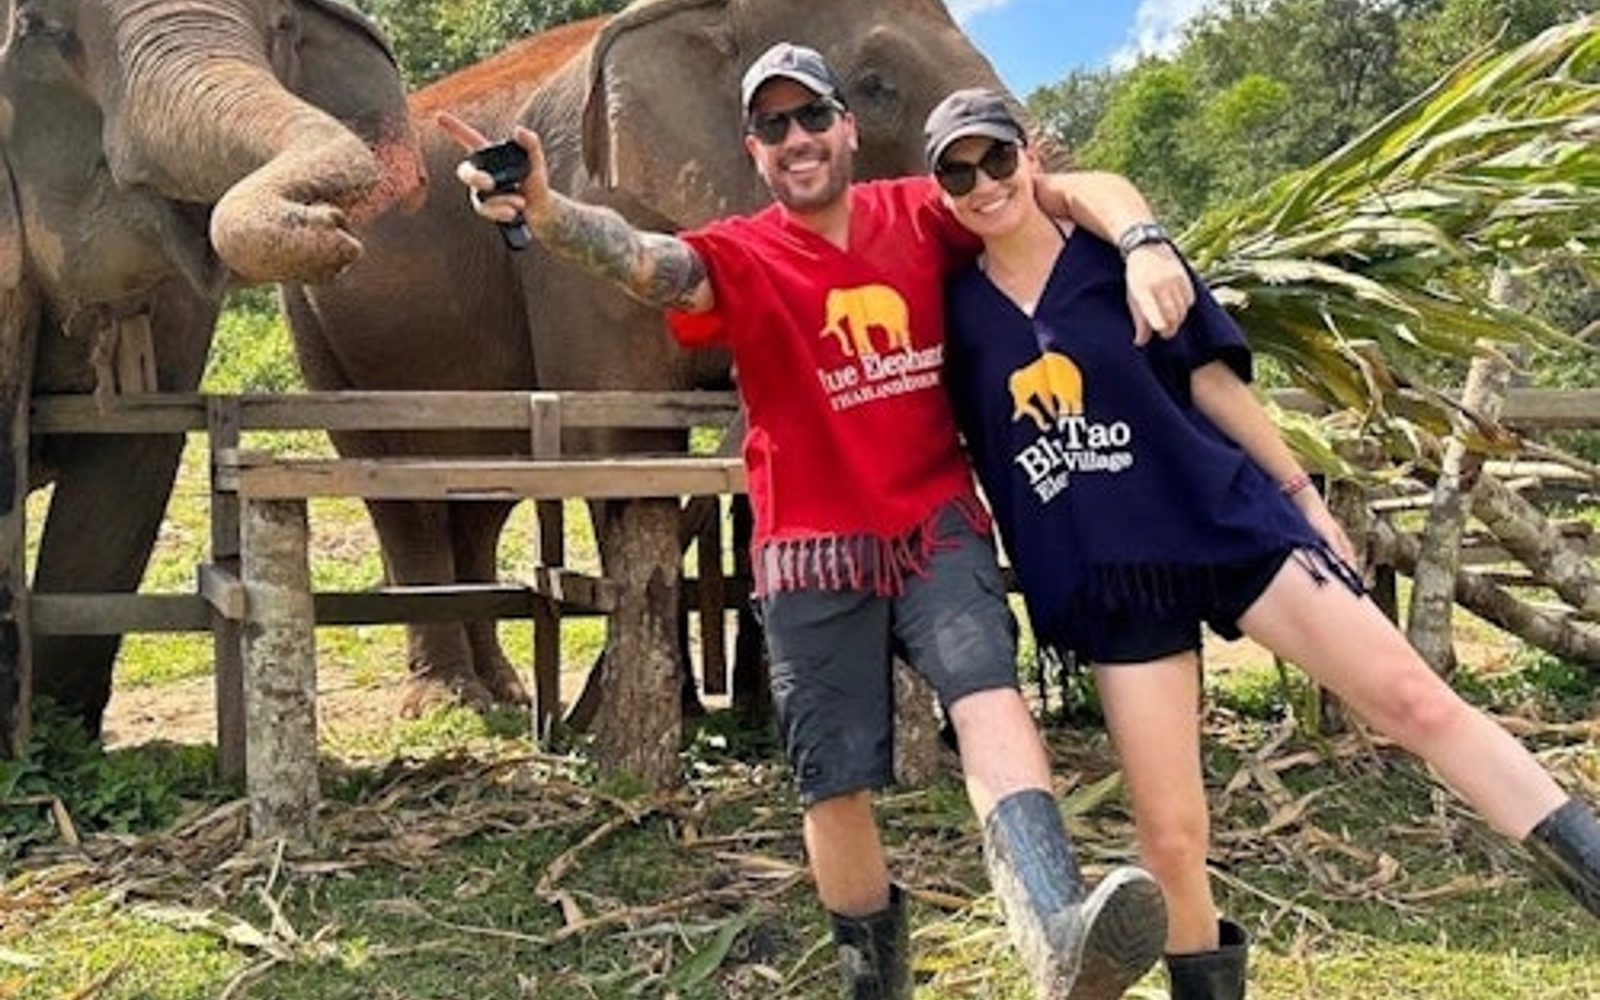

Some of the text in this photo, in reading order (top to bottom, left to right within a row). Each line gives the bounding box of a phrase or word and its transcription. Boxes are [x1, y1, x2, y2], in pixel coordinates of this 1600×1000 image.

[1014, 416, 1131, 484] Bl Tao
[1062, 450, 1133, 471] Village
